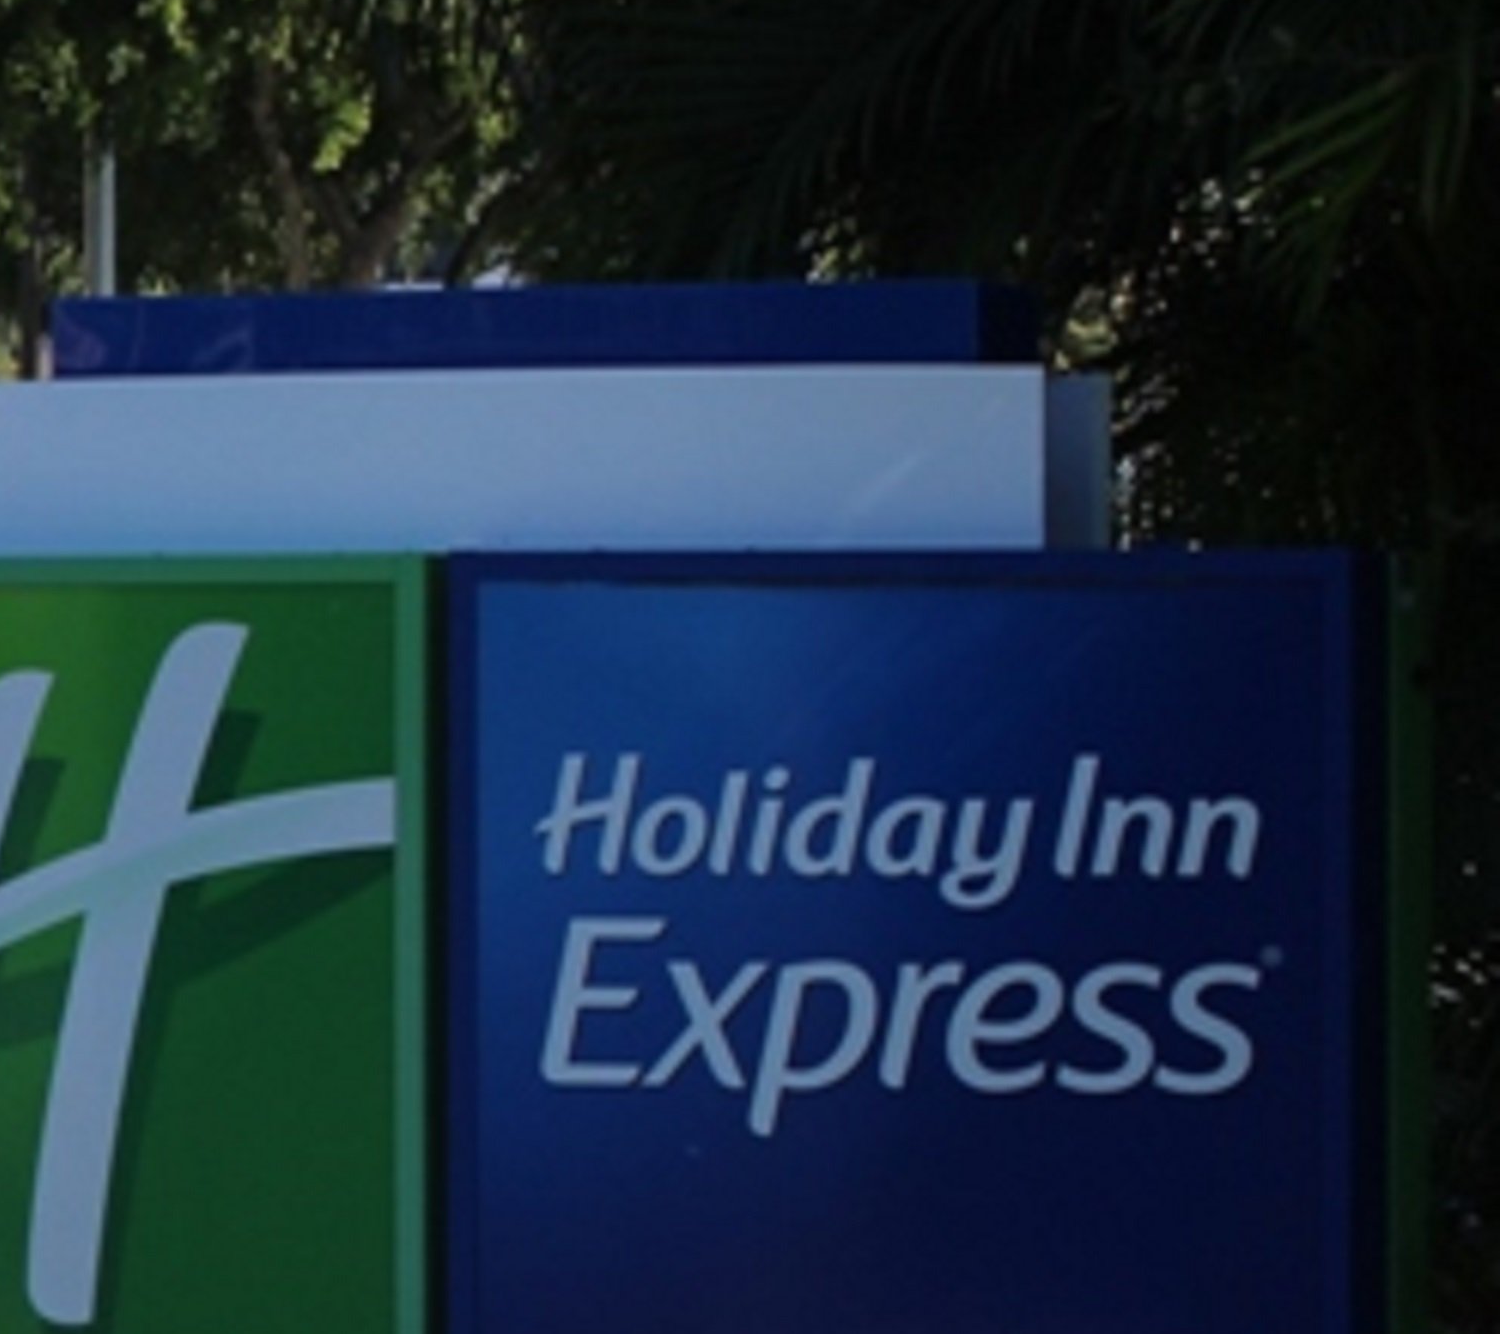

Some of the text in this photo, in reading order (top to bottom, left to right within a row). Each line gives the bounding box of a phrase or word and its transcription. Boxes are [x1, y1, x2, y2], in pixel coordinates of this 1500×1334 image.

[532, 751, 1260, 908] Holiday Inn
[538, 915, 1261, 1137] Express
